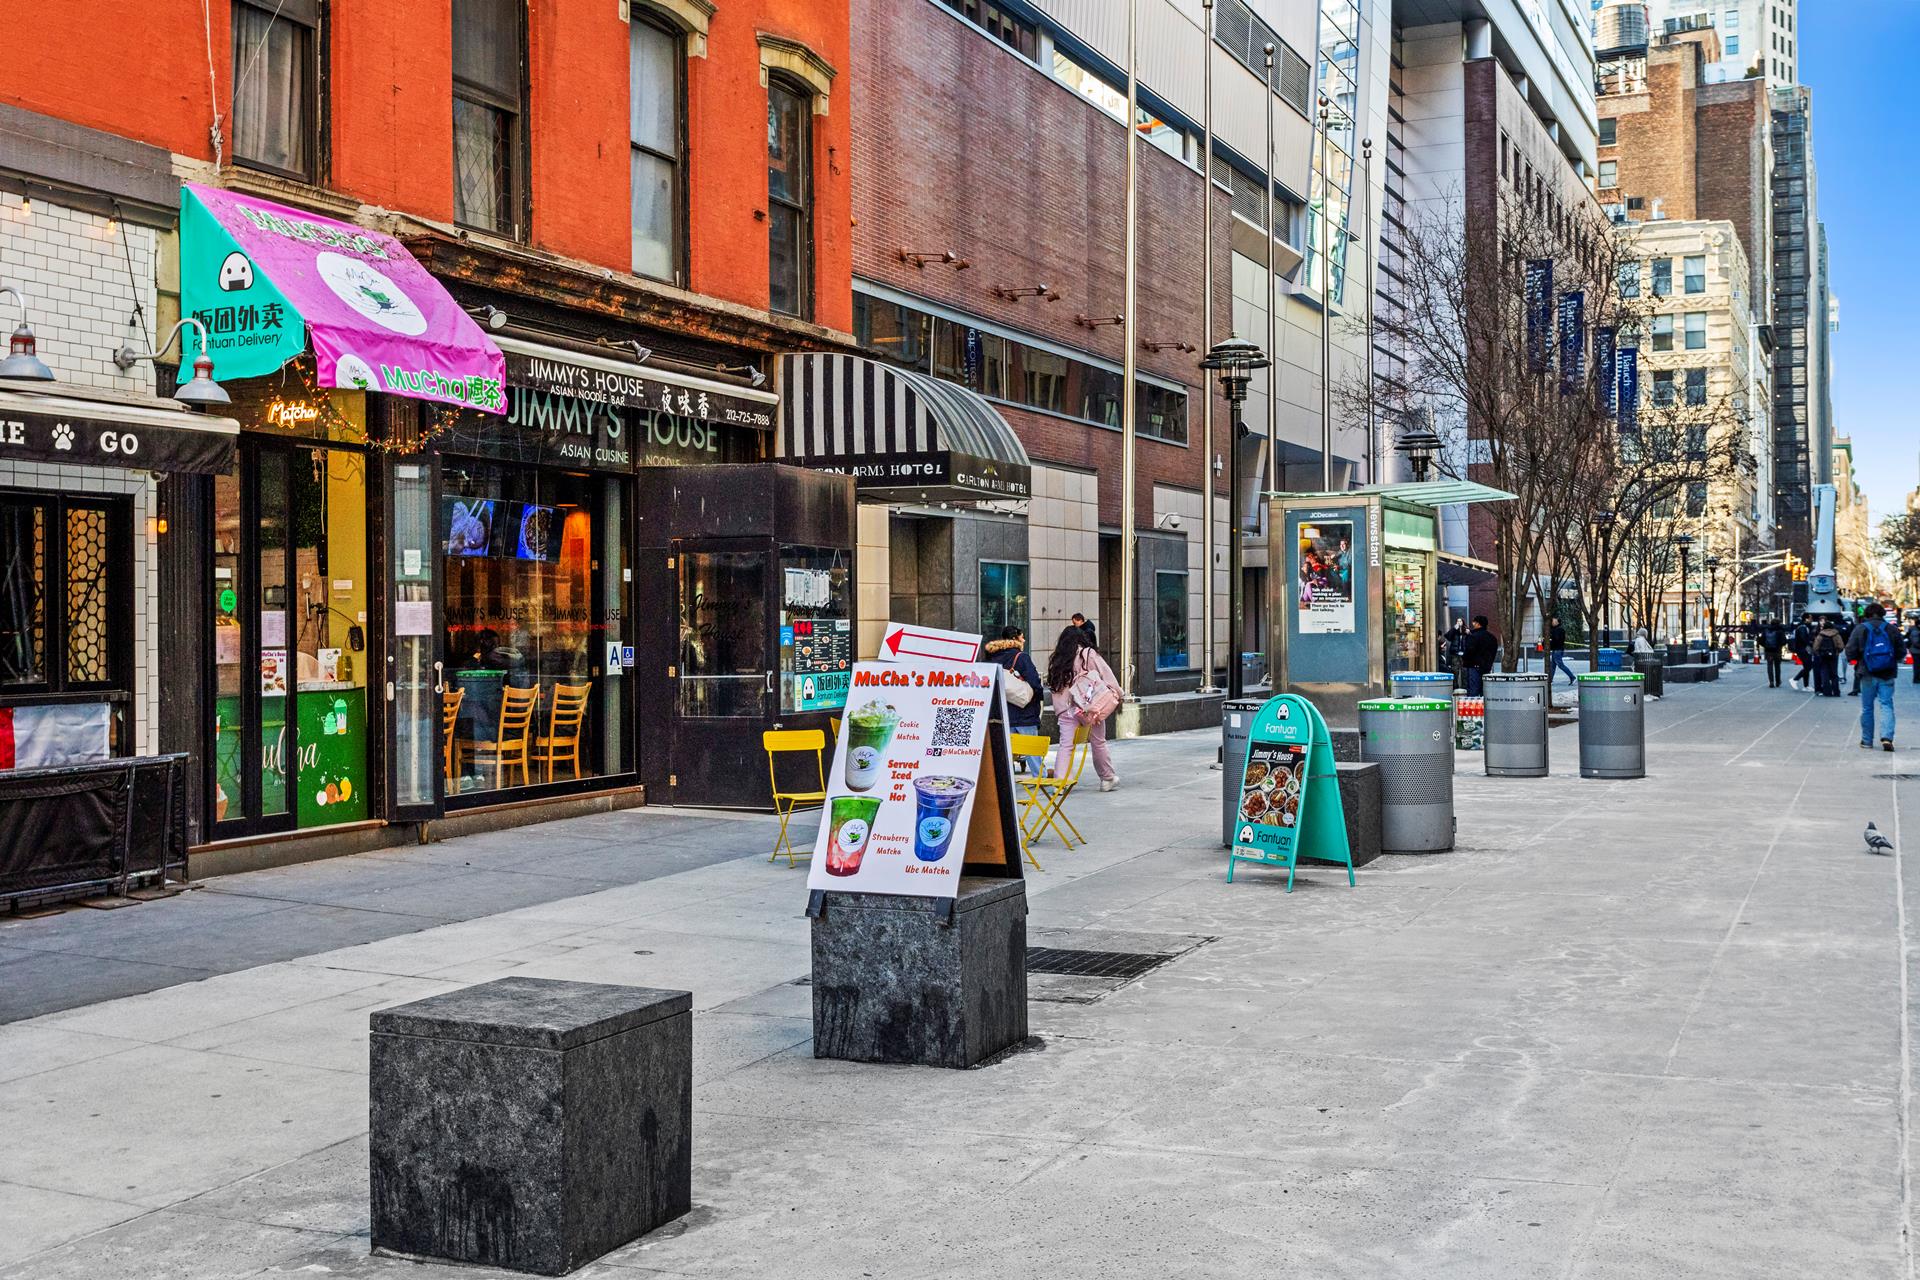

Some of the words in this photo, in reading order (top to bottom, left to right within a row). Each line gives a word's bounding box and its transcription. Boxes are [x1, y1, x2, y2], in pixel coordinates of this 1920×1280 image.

[238, 331, 283, 347] Delivery
[528, 358, 589, 387] JIMMY'S
[595, 371, 645, 397] HOUSE
[1623, 355, 1633, 386] Baruch
[380, 363, 465, 400] MuCha
[549, 383, 576, 397] ASIAN
[577, 387, 608, 404] NOODLE
[610, 394, 626, 407] BAR
[661, 385, 710, 420] 夜味香
[269, 401, 317, 428] Matcha
[507, 386, 621, 440] JIMMY'S
[99, 430, 139, 455] GO
[560, 443, 591, 459] ASIAN
[595, 447, 630, 464] CUISINE
[852, 465, 885, 477] ARMS
[1369, 505, 1381, 567] Newsstand
[609, 646, 620, 666] A
[854, 671, 925, 688] MuCha's
[927, 671, 990, 688] Matcha
[931, 698, 955, 707] Order
[956, 698, 985, 707] Online
[899, 720, 920, 729] Cookie
[1265, 722, 1298, 735] Fantuan
[896, 733, 920, 741] Matcha
[1251, 749, 1277, 761] Jimmy's
[1276, 751, 1294, 761] House
[887, 759, 920, 769] Served
[890, 771, 912, 780] Iced
[893, 783, 904, 791] or
[889, 793, 907, 802] Hot
[872, 833, 910, 844] Strawberry
[1256, 830, 1292, 846] Fantuan
[876, 847, 902, 856] Matcha
[905, 865, 920, 874] Ube
[921, 865, 950, 875] Matcha
